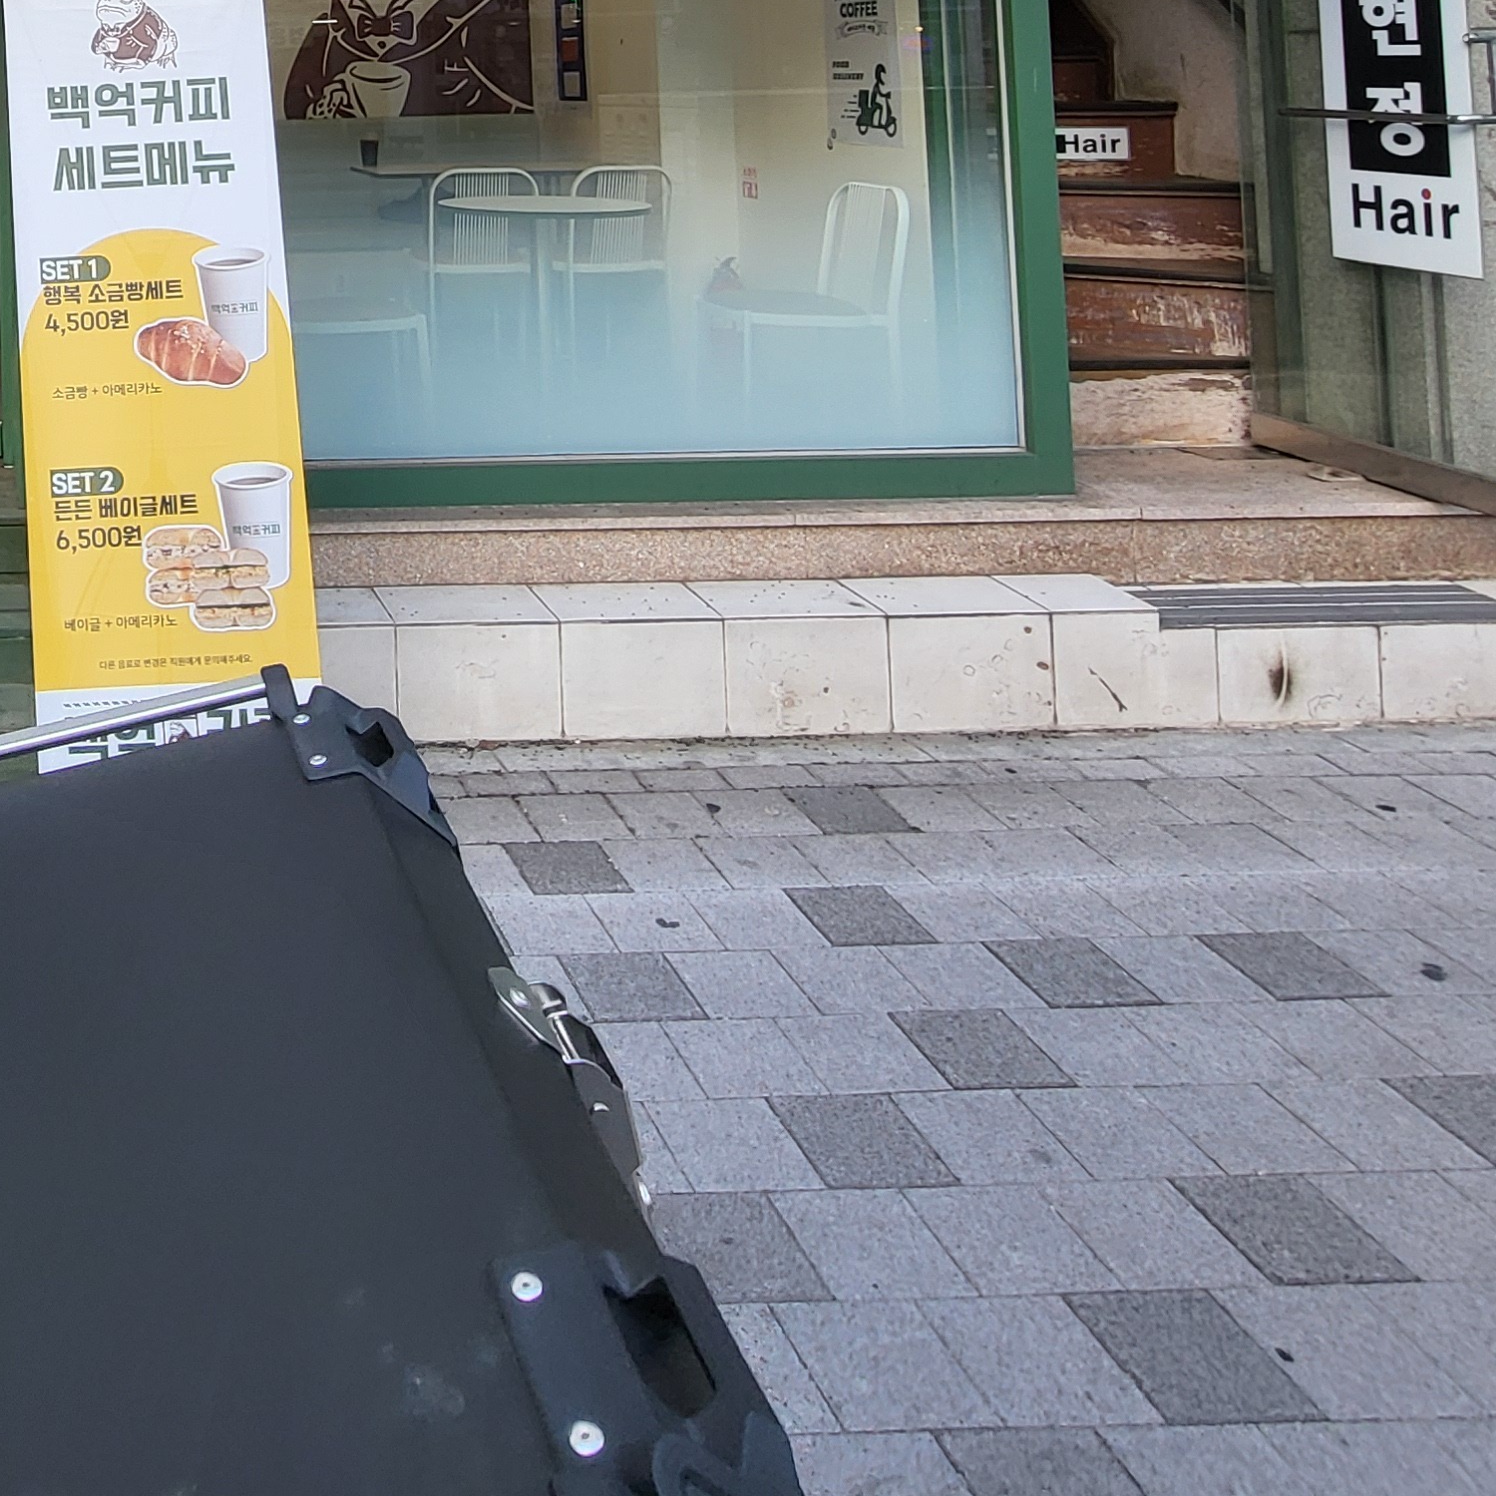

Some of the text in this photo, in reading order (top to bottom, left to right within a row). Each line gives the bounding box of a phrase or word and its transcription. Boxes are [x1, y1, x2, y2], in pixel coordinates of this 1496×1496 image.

[840, 0, 878, 18] COFFEE
[46, 76, 232, 130] 백억커피
[1061, 133, 1121, 154] Hair
[53, 139, 235, 192] 세트메뉴
[1352, 183, 1460, 240] Hair
[41, 258, 97, 282] SET 1
[42, 279, 184, 306] 행복 소금빵세트
[44, 309, 130, 336] 4,500원
[52, 384, 88, 400] 소금빵
[102, 381, 163, 397] 아메리카노
[52, 468, 116, 495] SET 2
[54, 494, 199, 522] 든든 베이글세트
[56, 525, 142, 555] 6,500원
[64, 616, 100, 632] 베이글
[115, 614, 178, 630] 아메리카노
[98, 660, 116, 670] 다른
[118, 659, 141, 669] 음료로
[143, 657, 167, 668] 변경은
[169, 656, 202, 666] 직원에게
